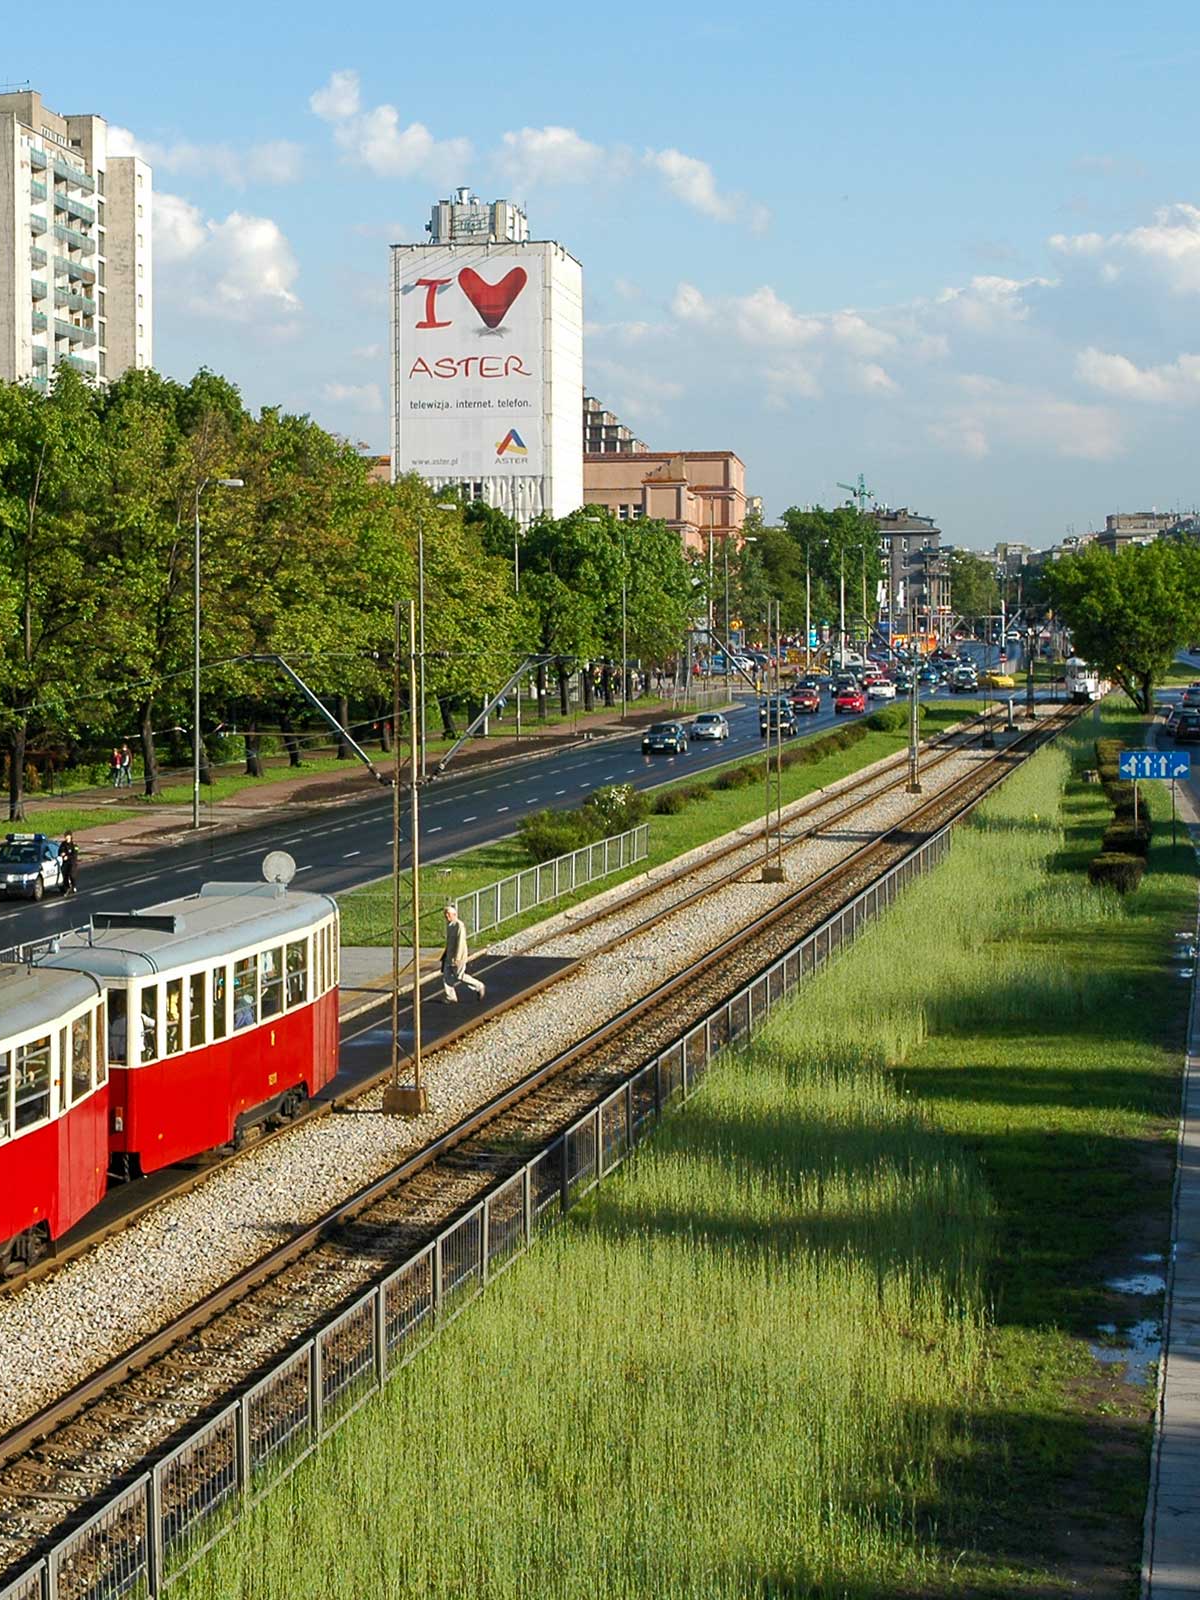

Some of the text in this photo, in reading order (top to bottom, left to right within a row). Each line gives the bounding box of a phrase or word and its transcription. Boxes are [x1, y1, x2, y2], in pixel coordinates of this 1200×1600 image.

[415, 278, 453, 329] I
[408, 354, 532, 379] ASTER
[409, 399, 532, 410] telewizja. internet. telefon.
[494, 457, 528, 465] ASTER
